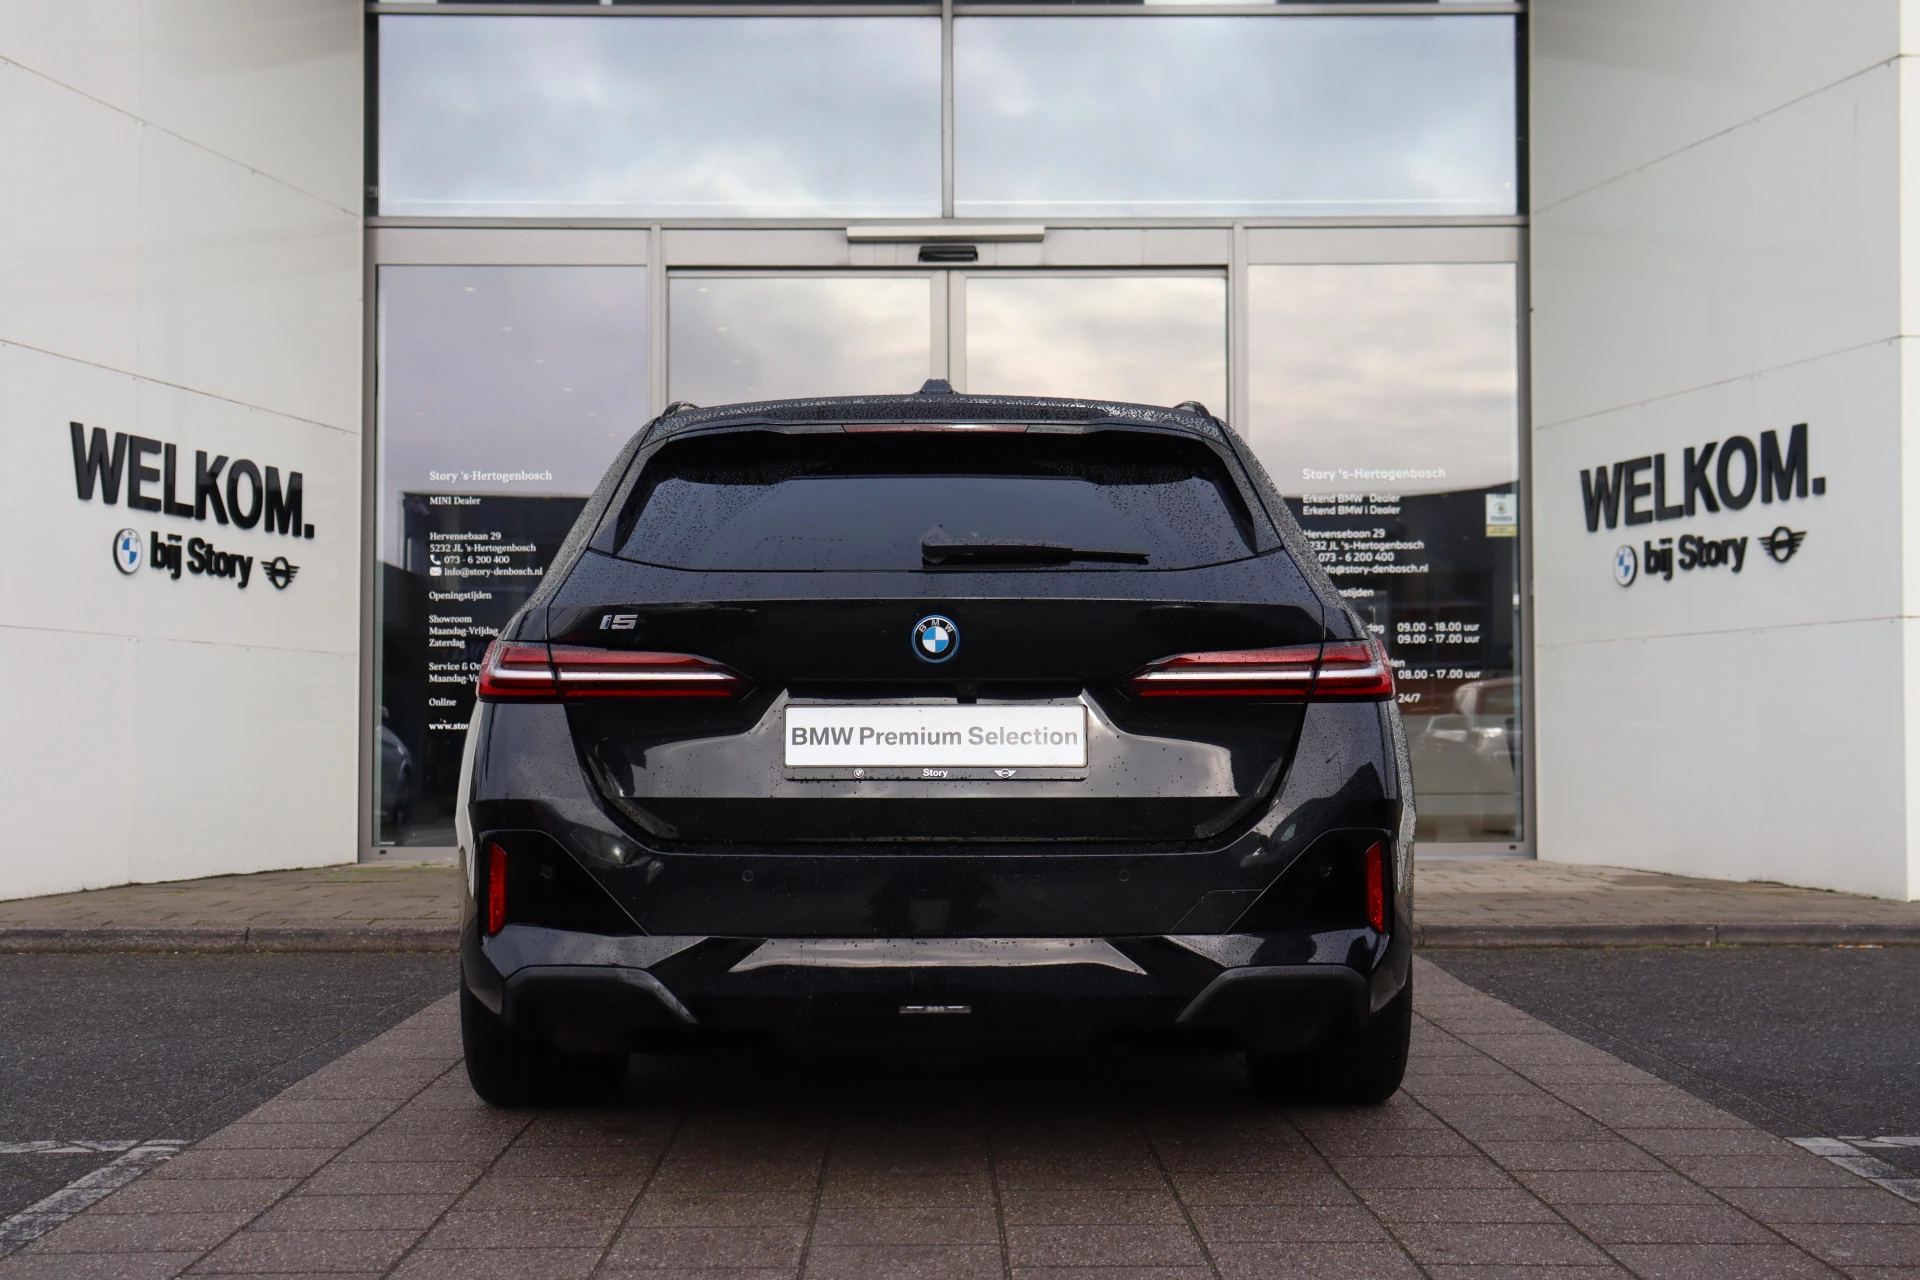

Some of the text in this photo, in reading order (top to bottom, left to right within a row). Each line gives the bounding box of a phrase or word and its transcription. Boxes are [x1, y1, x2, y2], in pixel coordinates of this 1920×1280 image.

[429, 470, 552, 483] Story 's-Hertogenbosch
[1302, 468, 1446, 481] Story 's-Hertogenbosch
[1580, 423, 1826, 533] WELKOM.
[69, 421, 315, 539] WELKOM.
[429, 496, 481, 505] MINI Dealer
[1303, 493, 1400, 504] Erkend BMW Dealer
[1303, 506, 1335, 515] Erkend
[1337, 506, 1363, 515] BMW
[1369, 505, 1401, 515] Dealer
[429, 531, 502, 541] Hervensebaan 29
[1372, 528, 1386, 538] 29
[429, 543, 537, 554] 5232 JL 's-Hertogenbosch
[1309, 540, 1424, 551] 232 JL 's-Hertogenbosch
[150, 531, 253, 589] bij Story
[444, 555, 461, 564] 073
[467, 555, 473, 564] 6
[476, 555, 492, 564] 200
[493, 555, 510, 564] 400
[1318, 552, 1336, 562] 073
[1345, 552, 1352, 562] 6
[1353, 552, 1373, 562] 200
[1374, 551, 1394, 562] 400
[1644, 534, 1749, 581] bij Story
[444, 566, 543, 577] info@story-denbosch.nl
[1323, 563, 1428, 575] fo@story-denbosch.nl
[429, 591, 492, 601] Openingstijden
[1338, 587, 1374, 599] stijden
[429, 615, 472, 623] Showroom
[600, 614, 638, 630] i5
[918, 619, 954, 633] BMW
[1397, 622, 1426, 632] 09.00
[1435, 622, 1462, 632] 18.00
[1463, 624, 1480, 632] uur
[429, 627, 498, 637] Maandag-Vrijdag
[429, 639, 465, 649] Zaterdag
[1397, 634, 1426, 644] 09.00
[1464, 635, 1480, 643] uur
[429, 662, 482, 671] Service & On
[429, 674, 479, 684] Maandag-Vr
[1398, 669, 1428, 679] 08.00
[1465, 671, 1481, 679] uur
[429, 698, 457, 706] Online
[1398, 693, 1421, 702] 24/7
[791, 726, 1078, 746] BMW Premium Selection
[922, 768, 949, 778] Story
